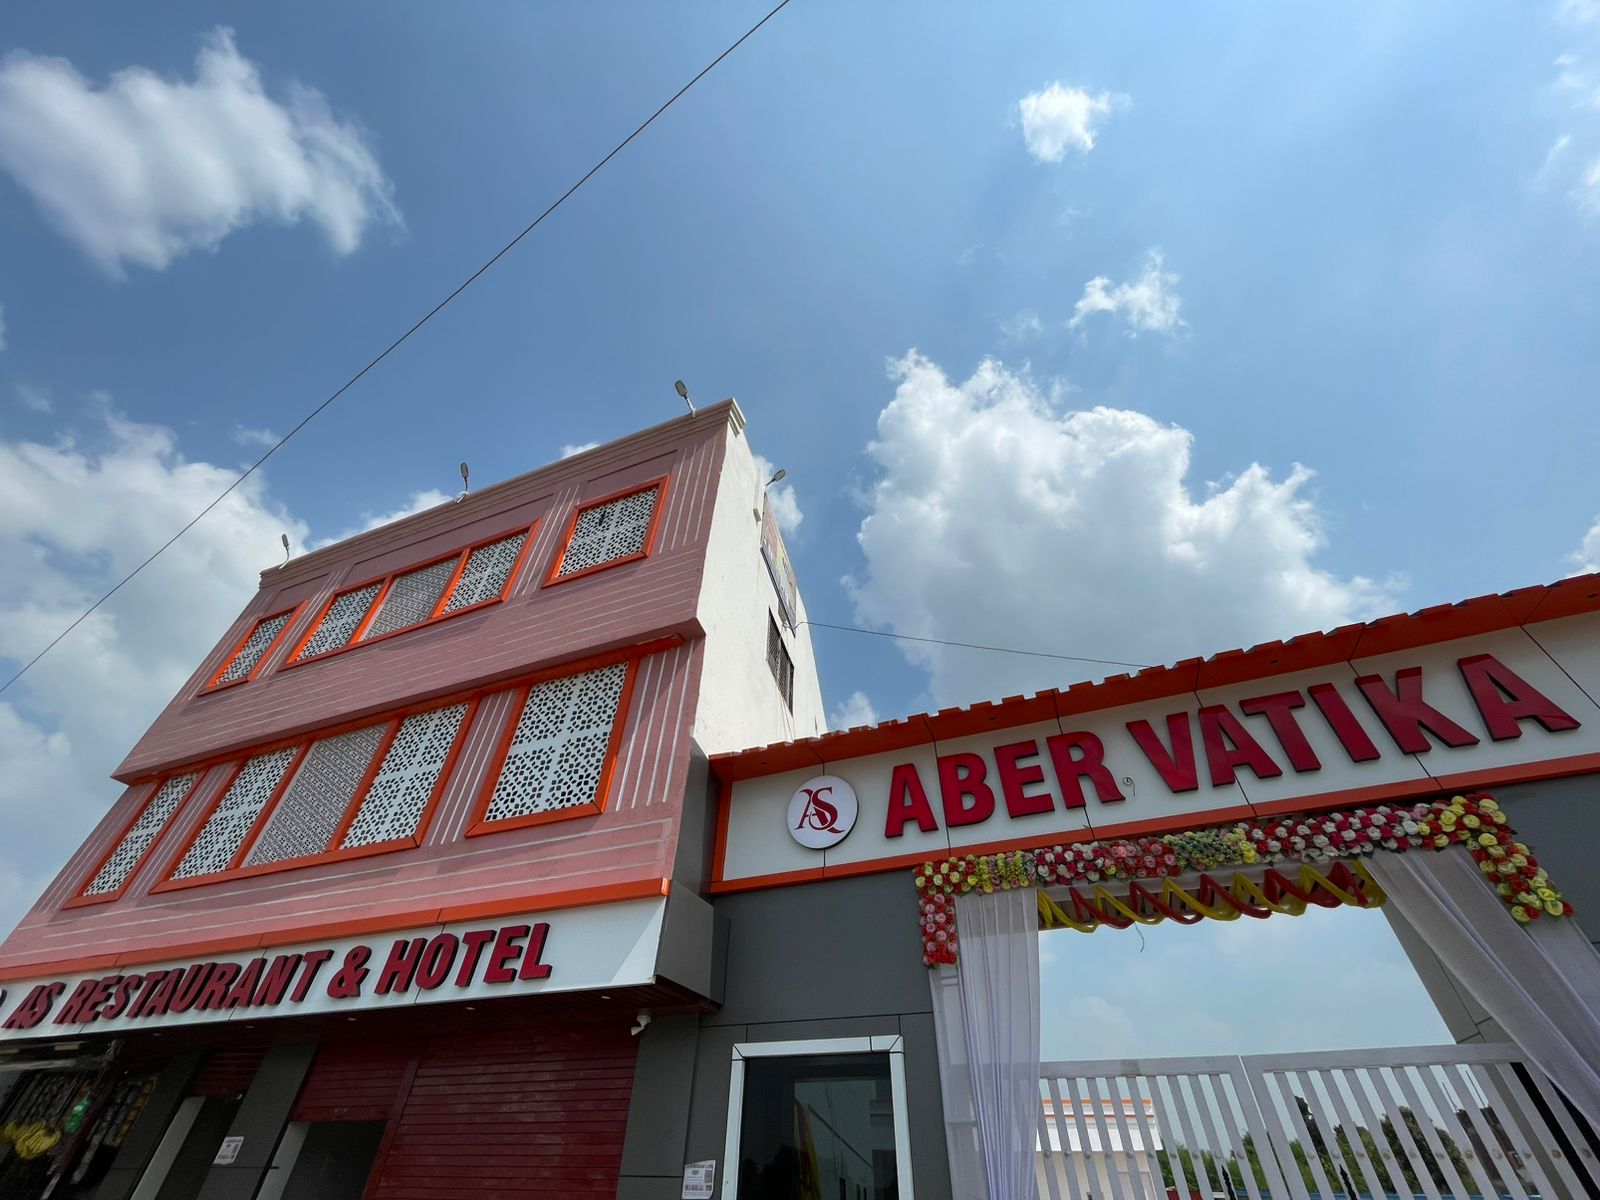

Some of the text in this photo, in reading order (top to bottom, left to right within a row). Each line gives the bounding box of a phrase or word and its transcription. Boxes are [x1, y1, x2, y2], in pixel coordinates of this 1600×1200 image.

[884, 653, 1581, 838] ABER VATIKA
[1, 922, 553, 1029] AS RESTAURANT & HOTEL
